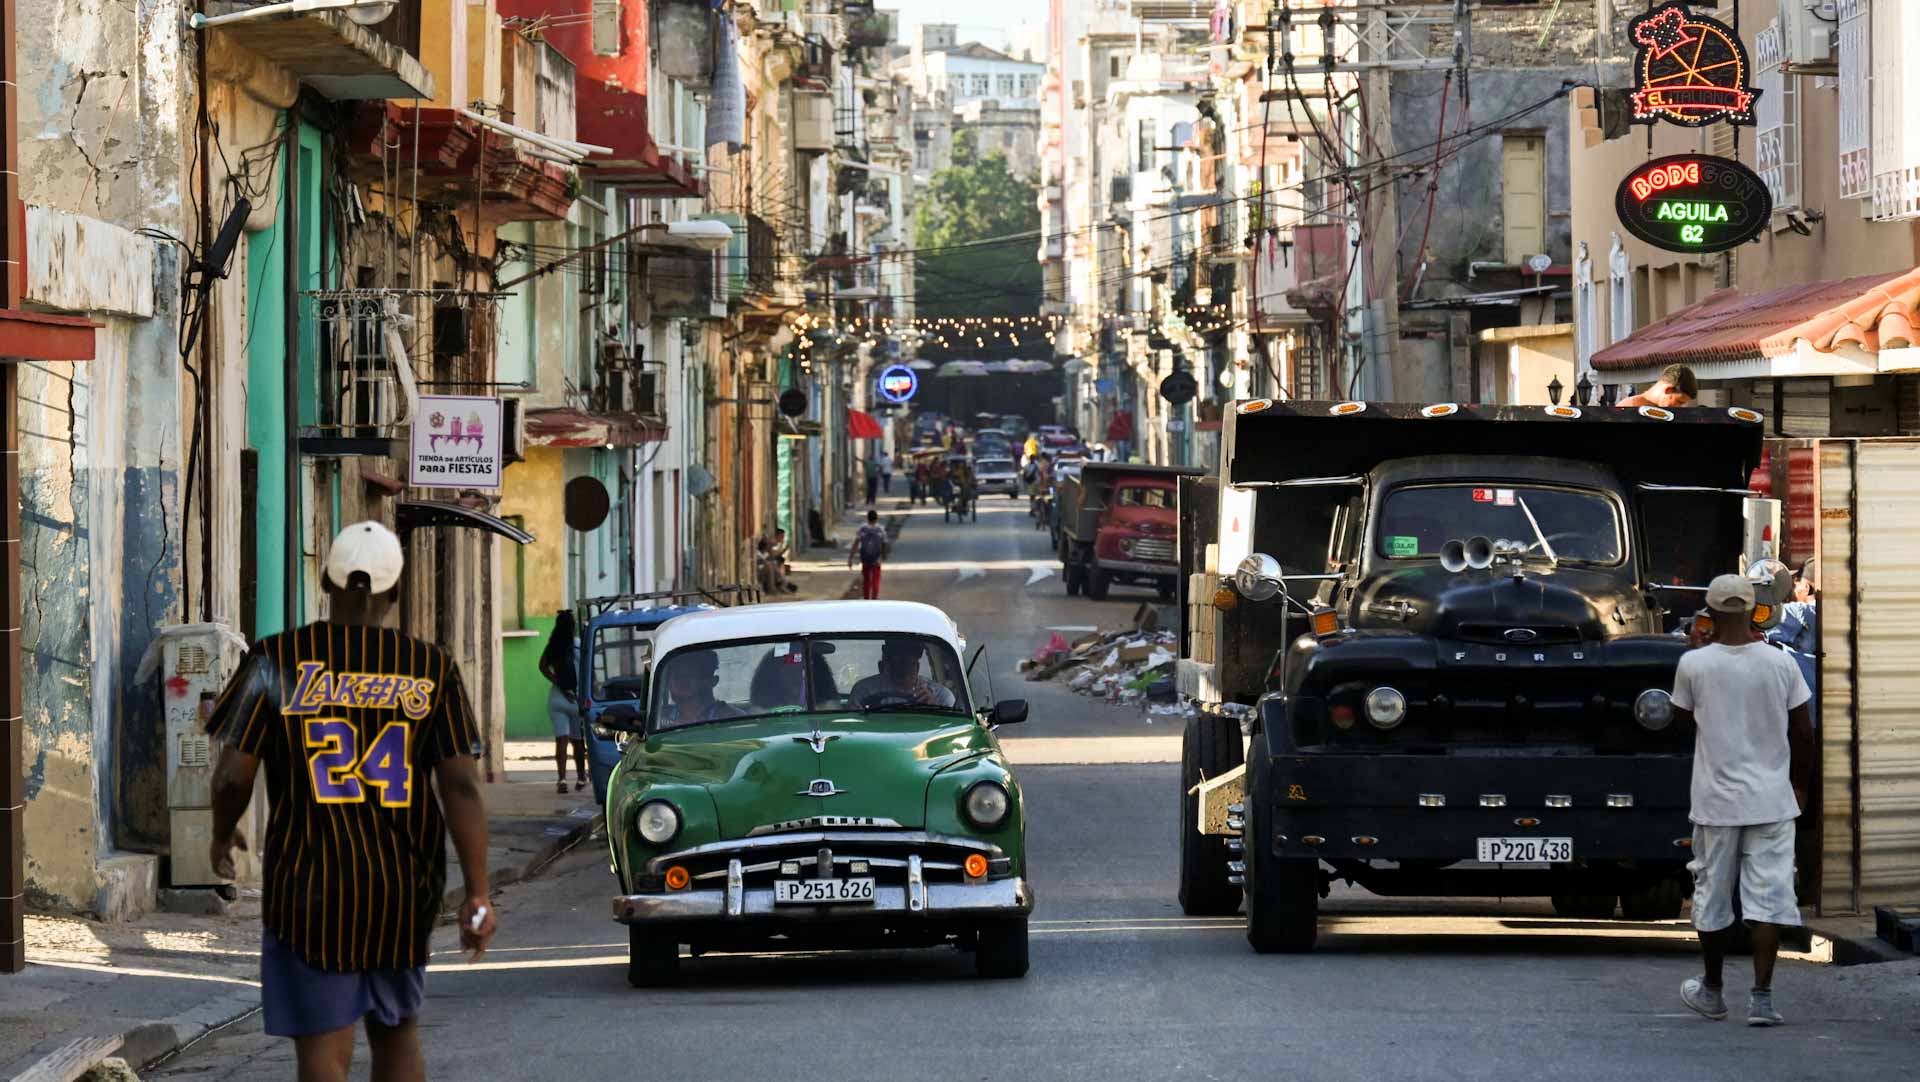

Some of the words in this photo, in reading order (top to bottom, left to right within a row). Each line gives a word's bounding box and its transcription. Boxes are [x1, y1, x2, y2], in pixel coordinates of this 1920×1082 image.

[1647, 91, 1666, 105] EL
[1657, 202, 1729, 221] AGUILA
[1680, 225, 1704, 242] 62
[448, 463, 493, 474] FIESTAS
[1455, 651, 1584, 661] FORD
[304, 717, 413, 808] 24
